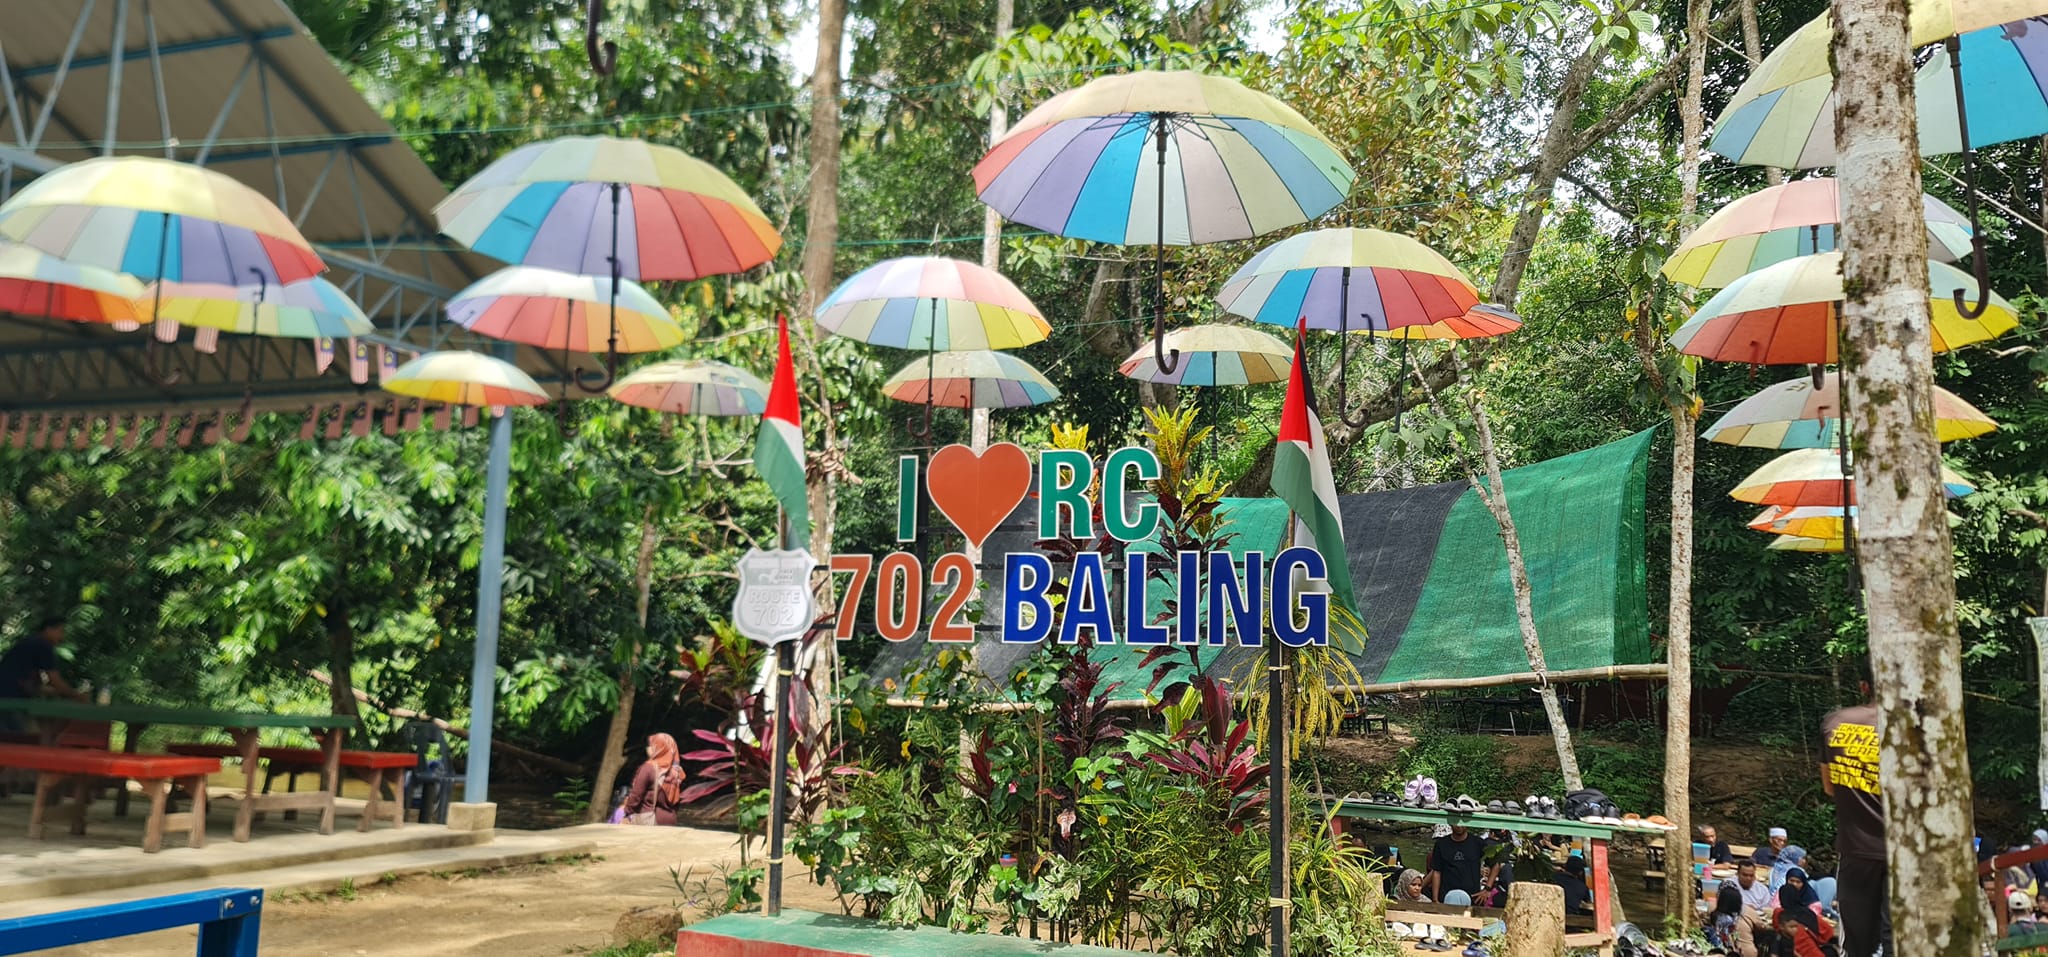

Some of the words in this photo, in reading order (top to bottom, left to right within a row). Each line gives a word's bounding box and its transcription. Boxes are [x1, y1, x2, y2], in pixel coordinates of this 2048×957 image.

[897, 455, 918, 542] I
[1038, 447, 1161, 541] RC
[748, 589, 801, 604] ROUTE
[831, 552, 977, 642] 702
[1002, 547, 1330, 647] BALING
[752, 605, 794, 626] 702
[1831, 731, 1880, 746] RIMB
[1847, 746, 1880, 757] CAF
